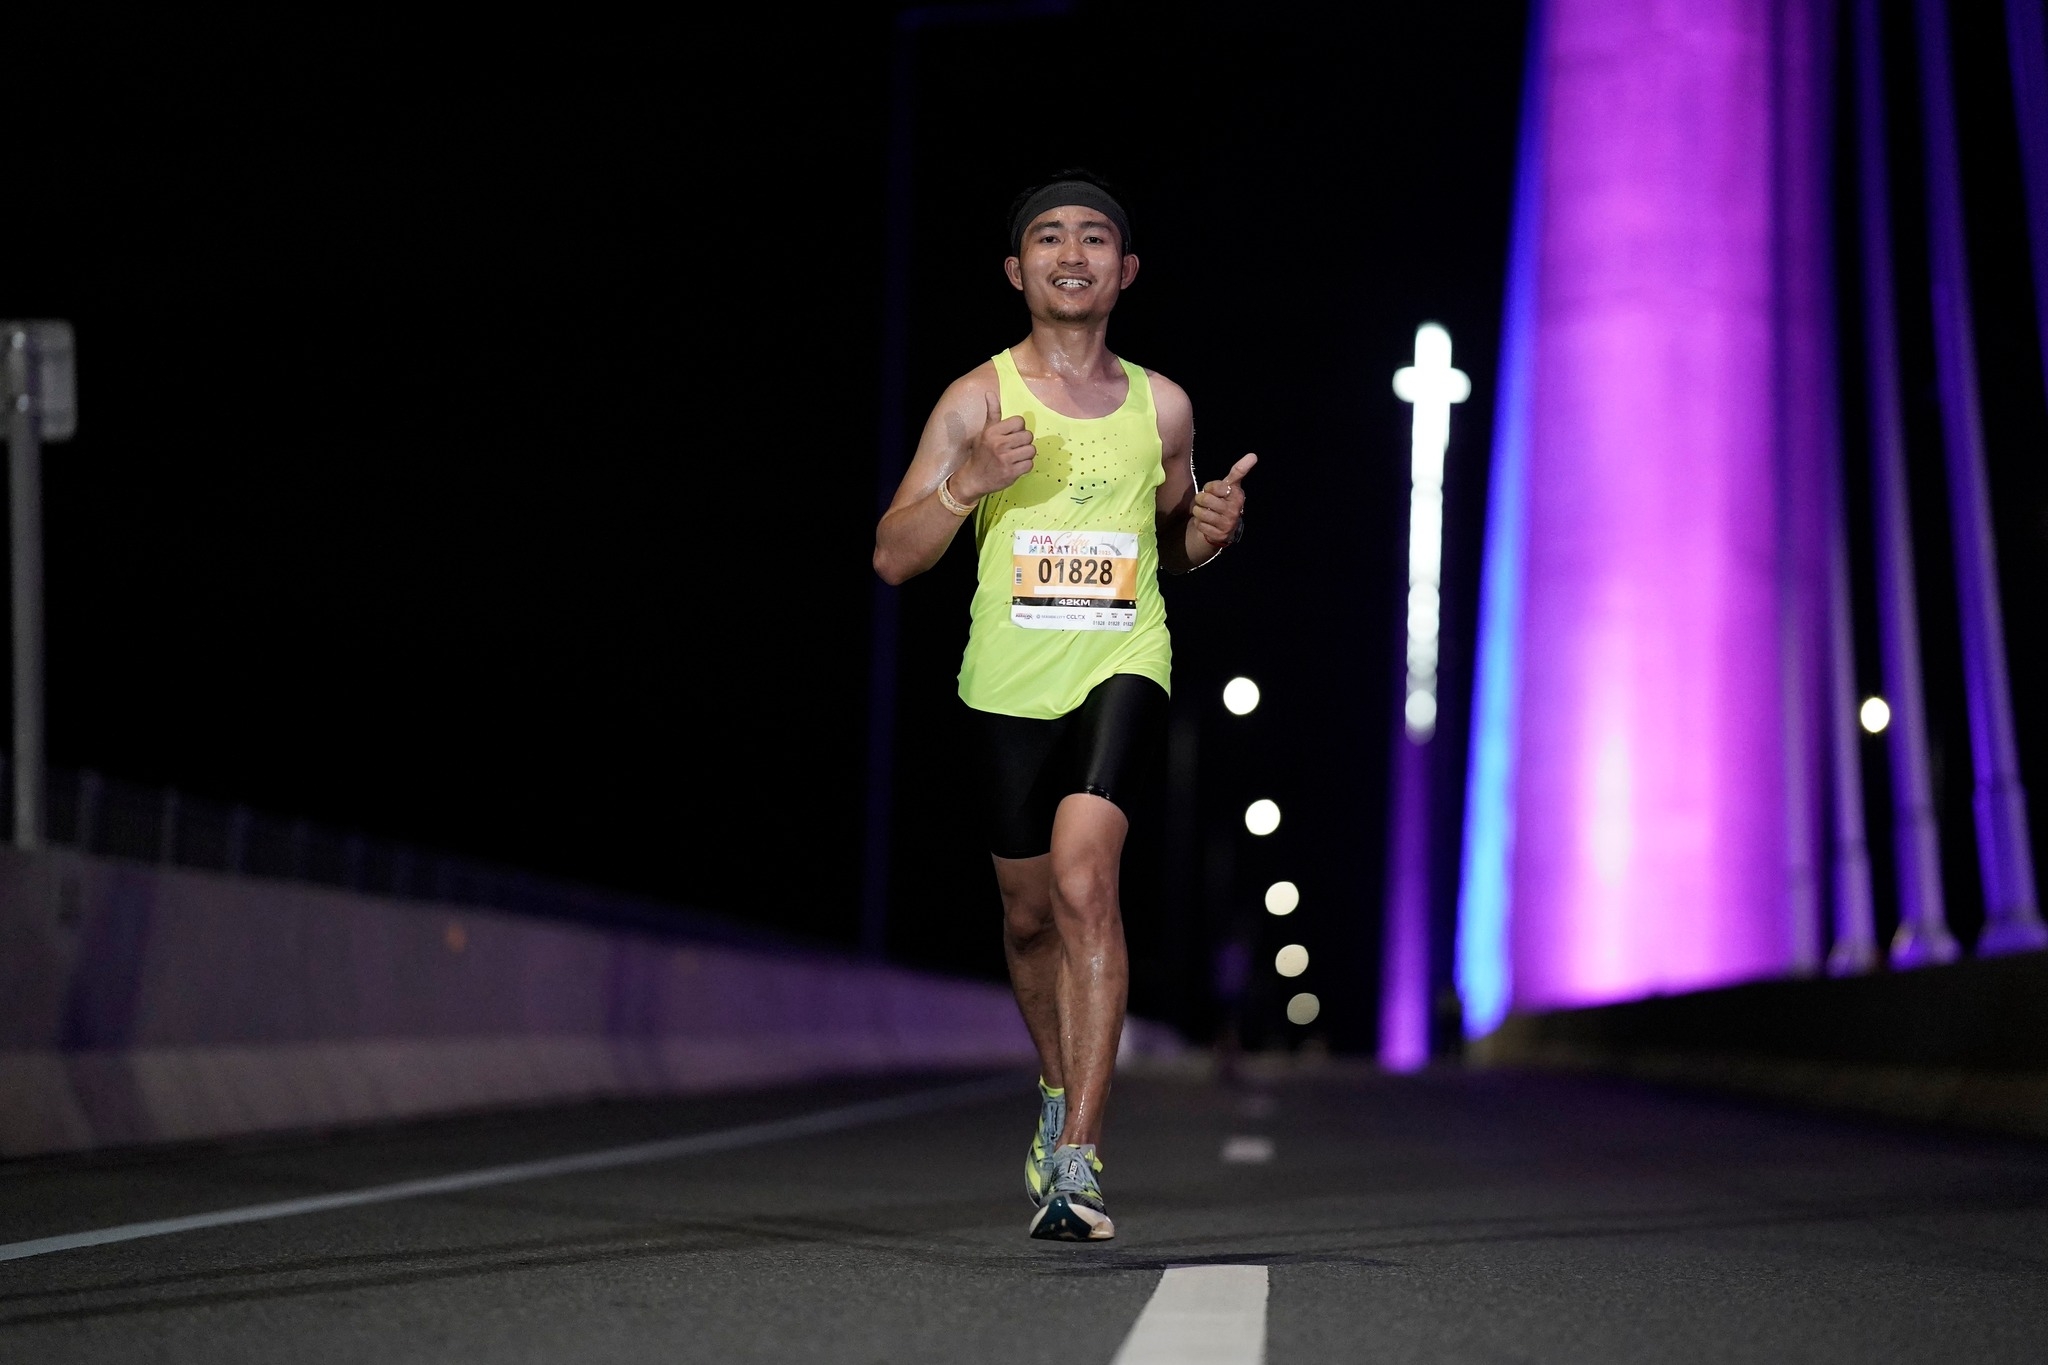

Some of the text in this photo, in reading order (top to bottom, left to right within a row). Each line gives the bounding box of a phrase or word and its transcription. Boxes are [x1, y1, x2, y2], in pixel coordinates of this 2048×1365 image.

[1030, 535, 1053, 545] AIA
[1028, 545, 1098, 556] MARATHON
[1038, 558, 1113, 585] 01828
[1058, 598, 1091, 606] 42KM
